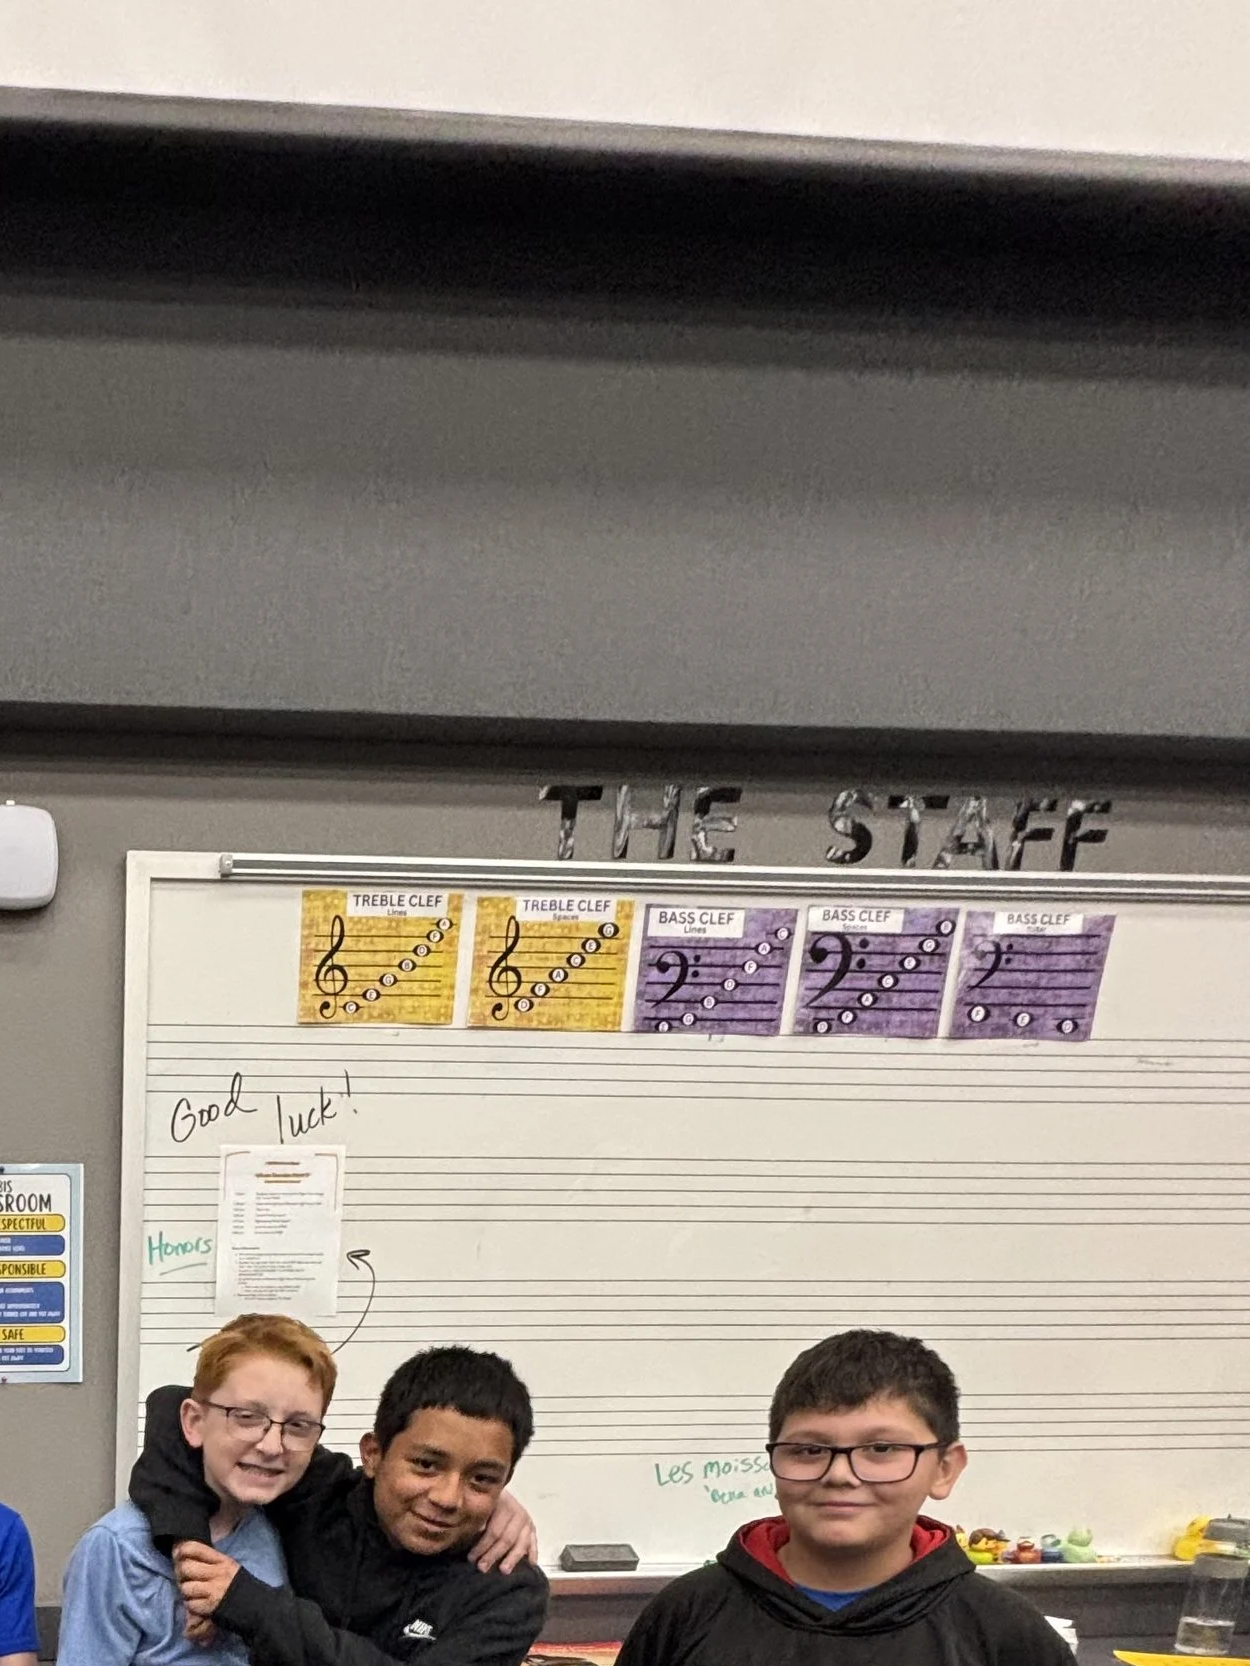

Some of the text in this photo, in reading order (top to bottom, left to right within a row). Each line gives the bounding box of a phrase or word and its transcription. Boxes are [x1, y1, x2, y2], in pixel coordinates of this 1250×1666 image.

[538, 784, 1112, 872] THE STAFF
[353, 894, 442, 908] TREBLE CLEF
[523, 899, 611, 912] TREBLE CLEF
[387, 908, 407, 916] Lines
[553, 913, 579, 921] Spaces
[659, 911, 735, 925] BASS CLEF
[822, 909, 891, 923] BASS CLEF
[1007, 913, 1070, 926] BASS CLEF
[684, 926, 707, 934] Lines
[170, 1069, 358, 1144] Good luck!
[148, 1231, 213, 1266] Honors
[1, 1328, 25, 1341] SAFE
[655, 1461, 694, 1487] Les
